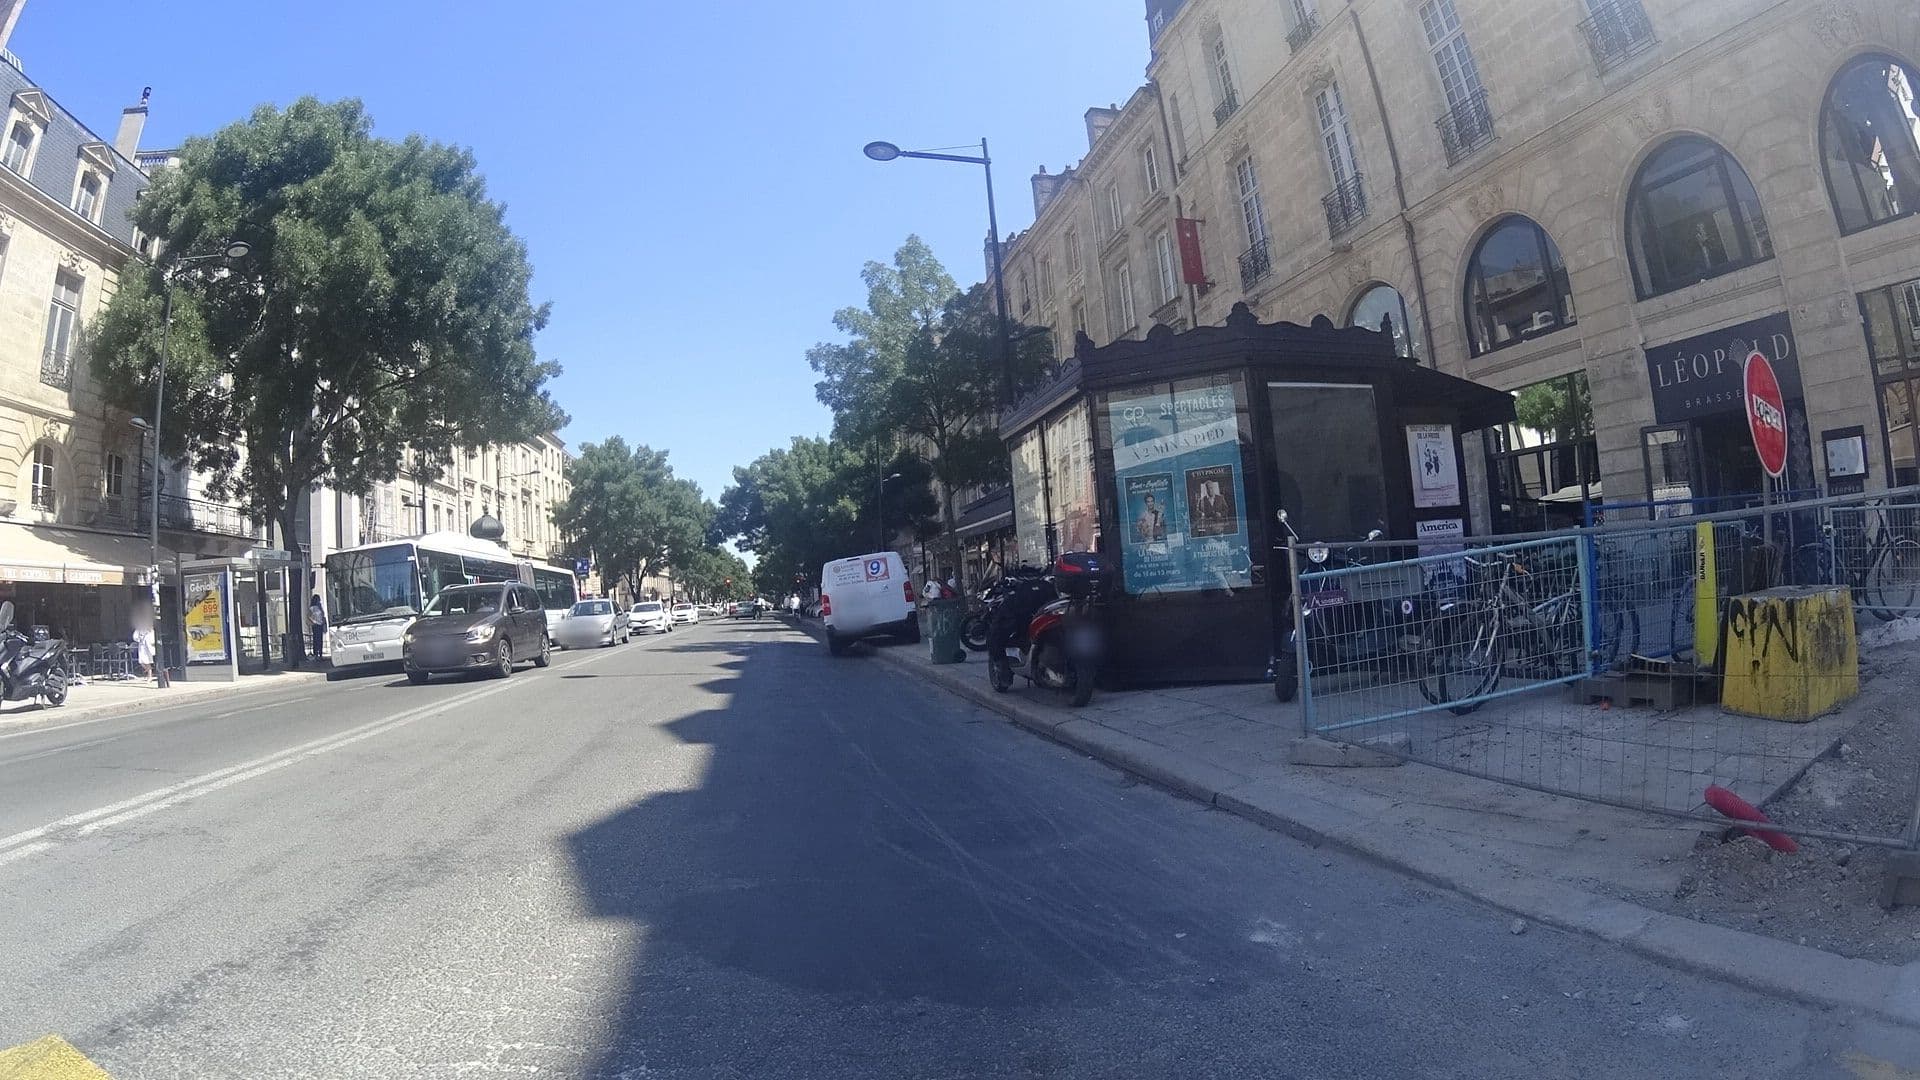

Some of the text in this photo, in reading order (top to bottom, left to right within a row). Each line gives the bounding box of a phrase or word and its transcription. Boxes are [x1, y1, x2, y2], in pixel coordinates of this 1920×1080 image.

[1160, 394, 1225, 416] SPECTACLES
[1685, 389, 1743, 409] BRASSE
[1194, 428, 1226, 446] PIED
[1420, 520, 1458, 533] America
[870, 560, 881, 575] 9
[203, 604, 218, 613] 899
